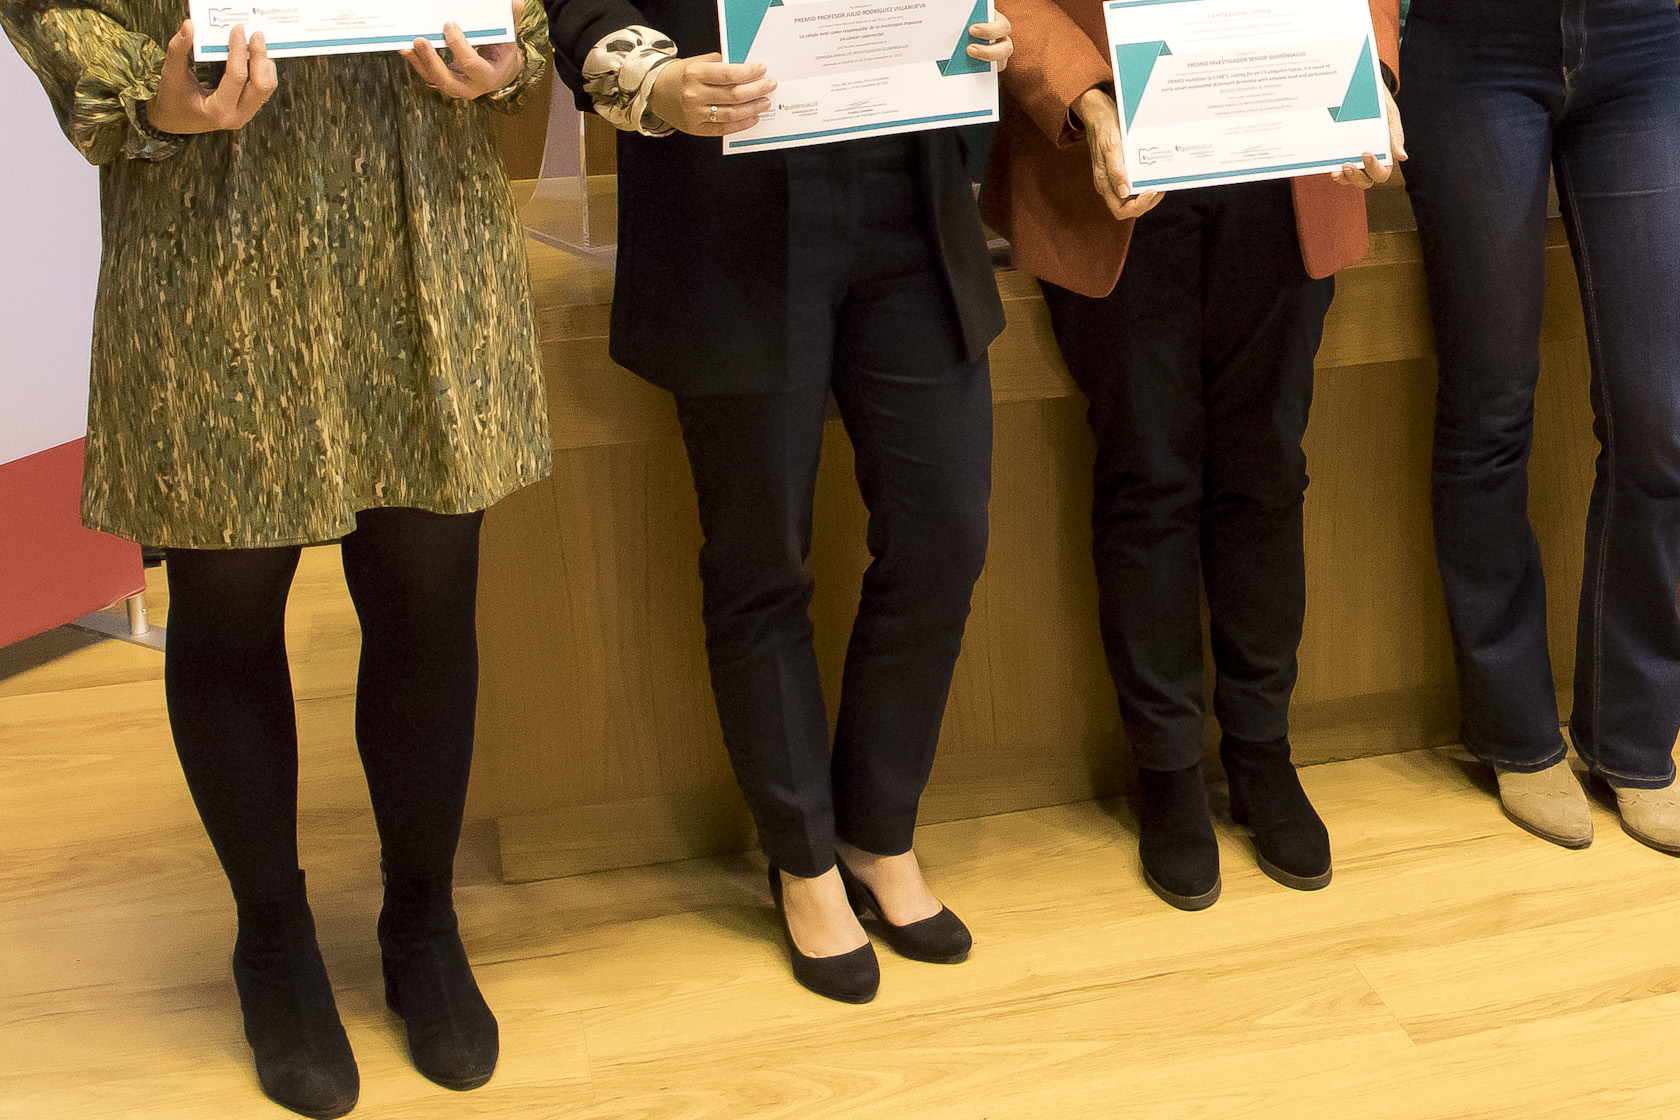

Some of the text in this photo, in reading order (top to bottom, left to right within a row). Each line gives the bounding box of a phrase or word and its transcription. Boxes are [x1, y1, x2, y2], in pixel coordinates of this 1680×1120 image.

[794, 15, 816, 24] PREMIO
[817, 12, 845, 21] PROFESOR
[845, 10, 862, 18] JULIO
[862, 6, 893, 16] RODRÍGUEZ
[1187, 60, 1209, 68] PREMIO
[1208, 57, 1248, 66] INVESTIGADOR
